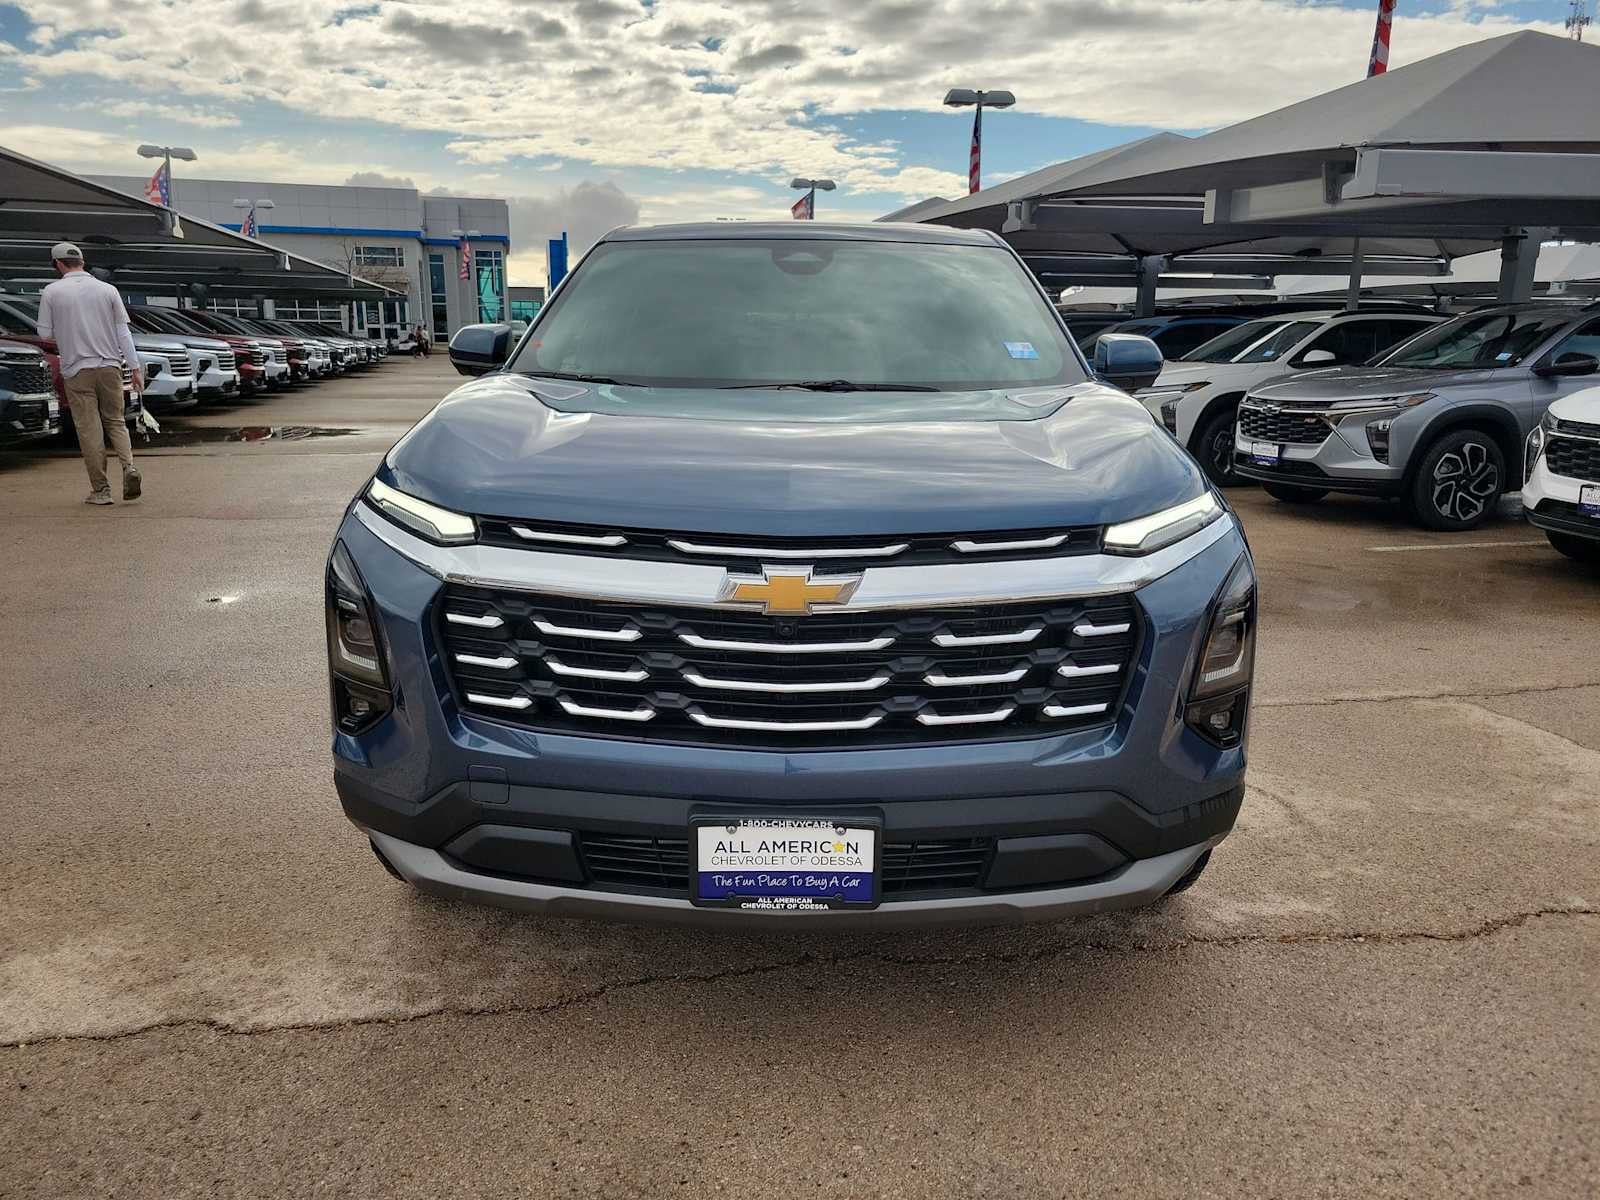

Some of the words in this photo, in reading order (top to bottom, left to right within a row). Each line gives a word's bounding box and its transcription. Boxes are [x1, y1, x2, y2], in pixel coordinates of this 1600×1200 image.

[738, 820, 833, 829] 1-800-CHEVYCARS
[714, 841, 750, 854] ALL
[758, 841, 858, 854] AMERICN
[711, 856, 786, 866] CHEVROLET
[790, 856, 806, 866] OF
[811, 856, 862, 866] ODESSA
[712, 875, 732, 887] The
[735, 876, 755, 886] Fun
[758, 875, 787, 887] Place
[789, 876, 803, 887] To
[805, 876, 827, 890] Buy
[829, 876, 839, 887] A
[841, 876, 861, 887] Car
